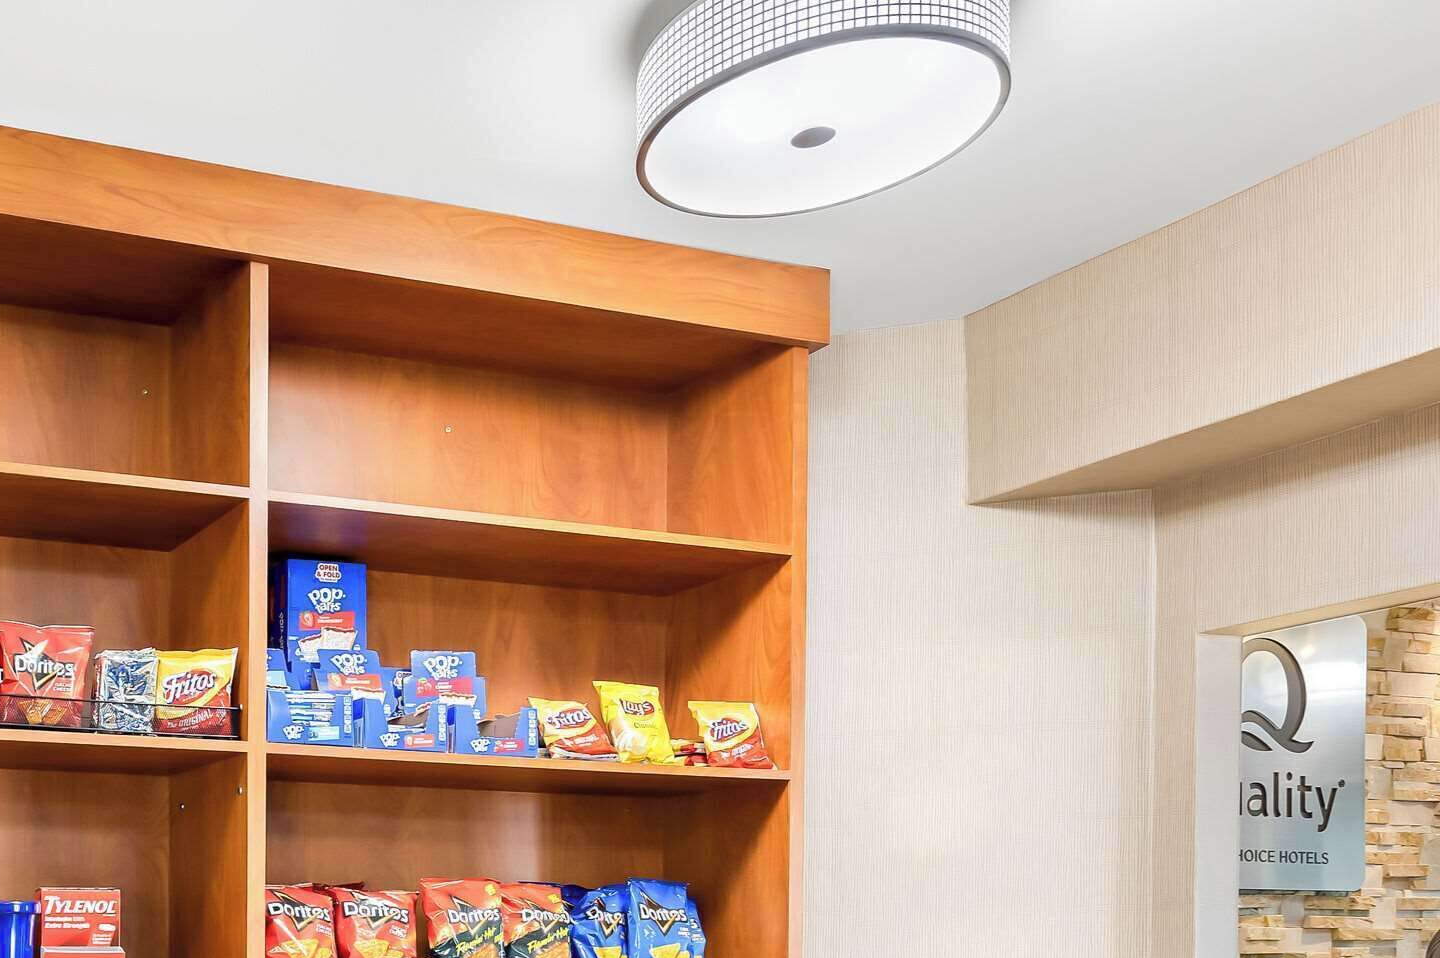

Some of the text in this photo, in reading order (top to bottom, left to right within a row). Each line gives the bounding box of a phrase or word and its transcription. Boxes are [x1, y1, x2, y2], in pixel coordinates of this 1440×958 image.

[14, 654, 75, 677] Doritos
[162, 671, 217, 704] Fritos
[1240, 771, 1338, 832] ality
[1238, 849, 1329, 865] HOICE HOTELS
[44, 895, 118, 914] TYLENOL
[267, 902, 331, 922] Doritos
[343, 901, 409, 923] Doritos
[639, 903, 687, 923] Doritos
[448, 908, 501, 923] Doritos
